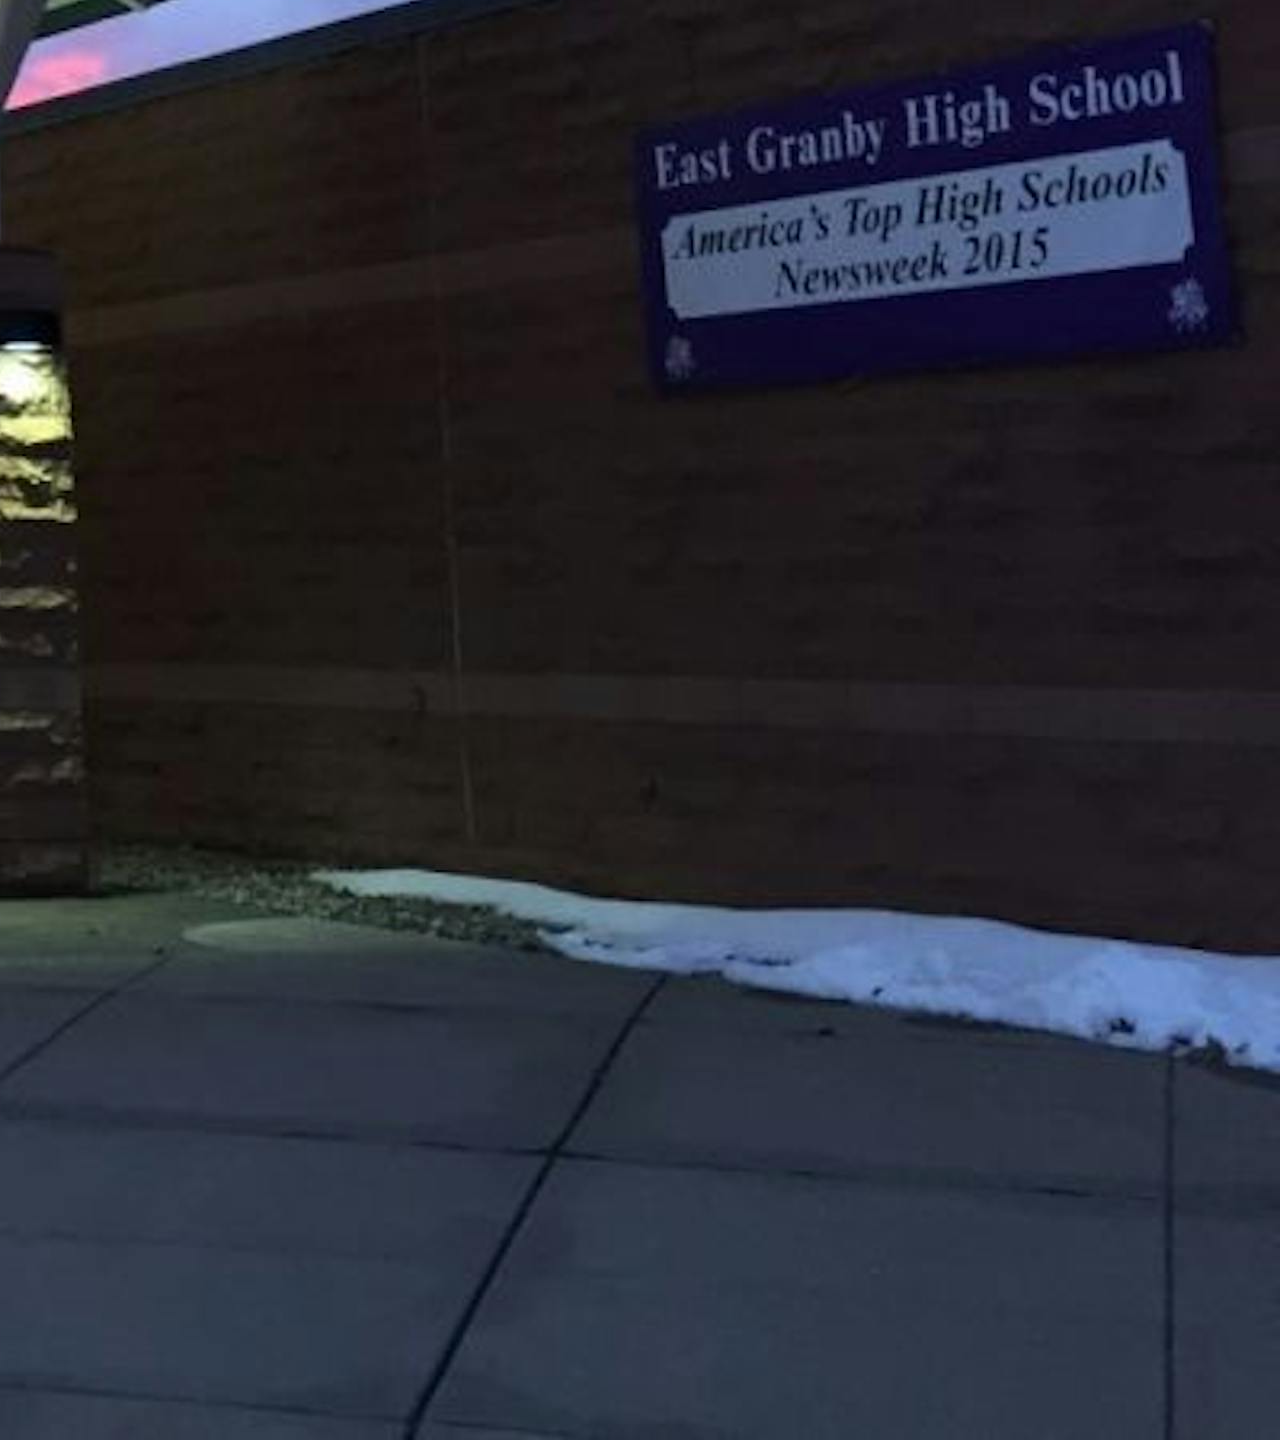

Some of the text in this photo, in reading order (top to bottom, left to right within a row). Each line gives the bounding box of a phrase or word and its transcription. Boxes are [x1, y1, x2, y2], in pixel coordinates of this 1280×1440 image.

[652, 49, 1185, 191] East Granby High School
[670, 153, 1170, 261] America's Top High Schools
[773, 226, 1050, 299] Newsweek 2015
